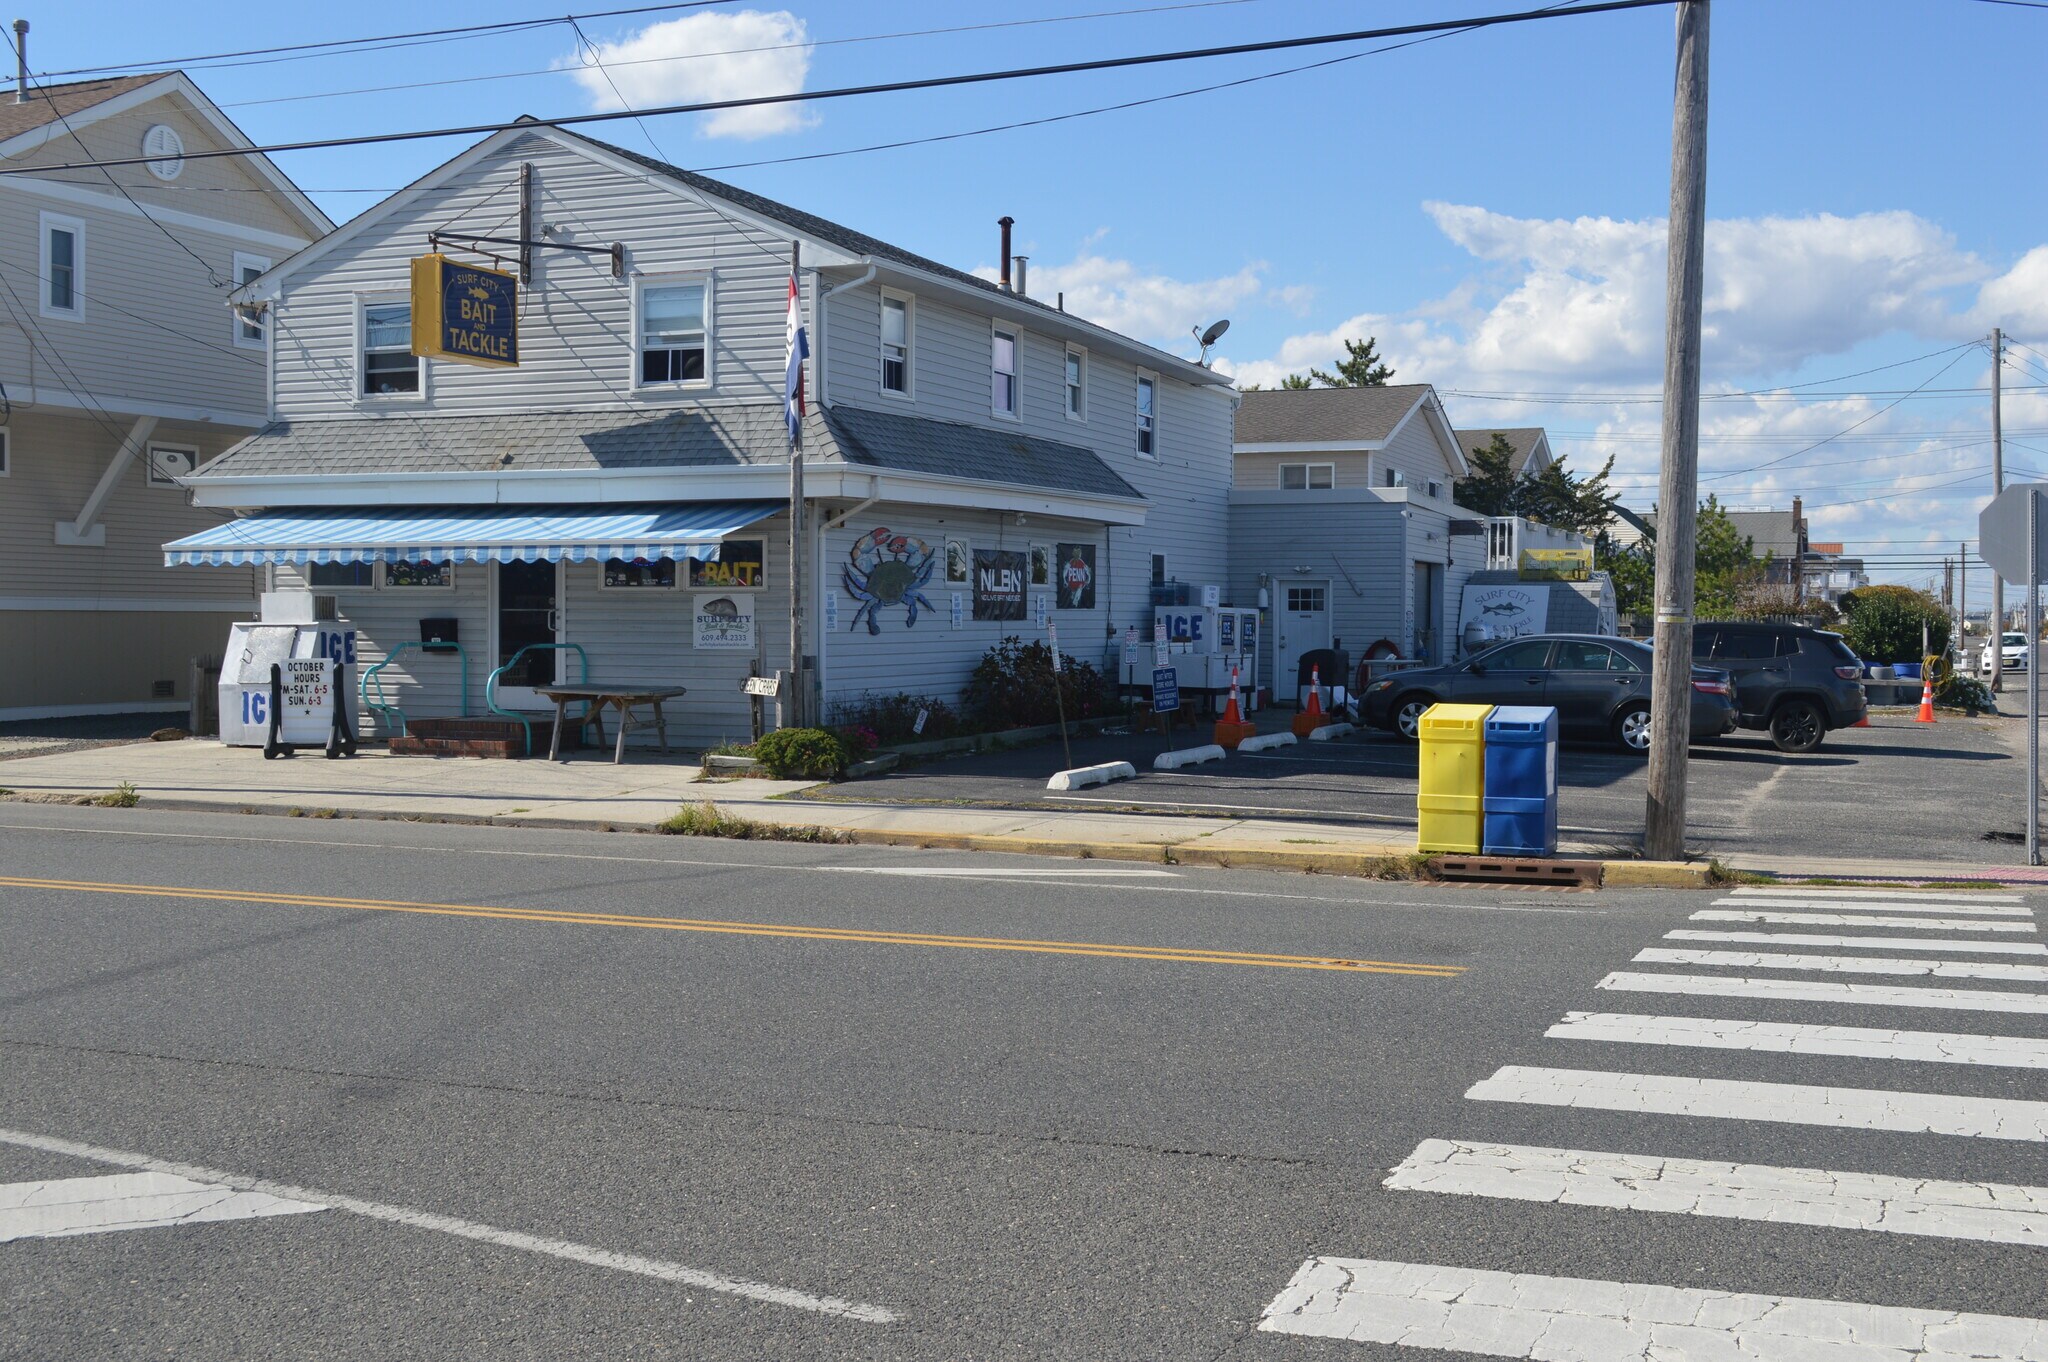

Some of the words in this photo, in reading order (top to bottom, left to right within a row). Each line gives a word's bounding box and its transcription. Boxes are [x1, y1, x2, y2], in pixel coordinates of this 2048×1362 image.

[457, 274, 478, 285] SURF
[480, 277, 500, 292] CITY
[461, 299, 497, 324] BAIT
[473, 323, 486, 331] AND
[449, 327, 508, 358] TACKLE
[705, 561, 760, 586] BAIT
[980, 568, 1022, 593] NLBN
[1068, 567, 1085, 582] PENN
[1475, 589, 1505, 606] SURF
[1508, 589, 1535, 605] CITY
[1166, 614, 1203, 640] ICE
[321, 631, 356, 665] ICE
[288, 662, 324, 672] OCTOBER
[294, 673, 320, 683] HOURS
[315, 684, 328, 694] 6-5
[758, 679, 776, 695] CRABS
[242, 691, 272, 725] IC
[288, 696, 307, 706] SUN.
[308, 696, 322, 706] 6-3
